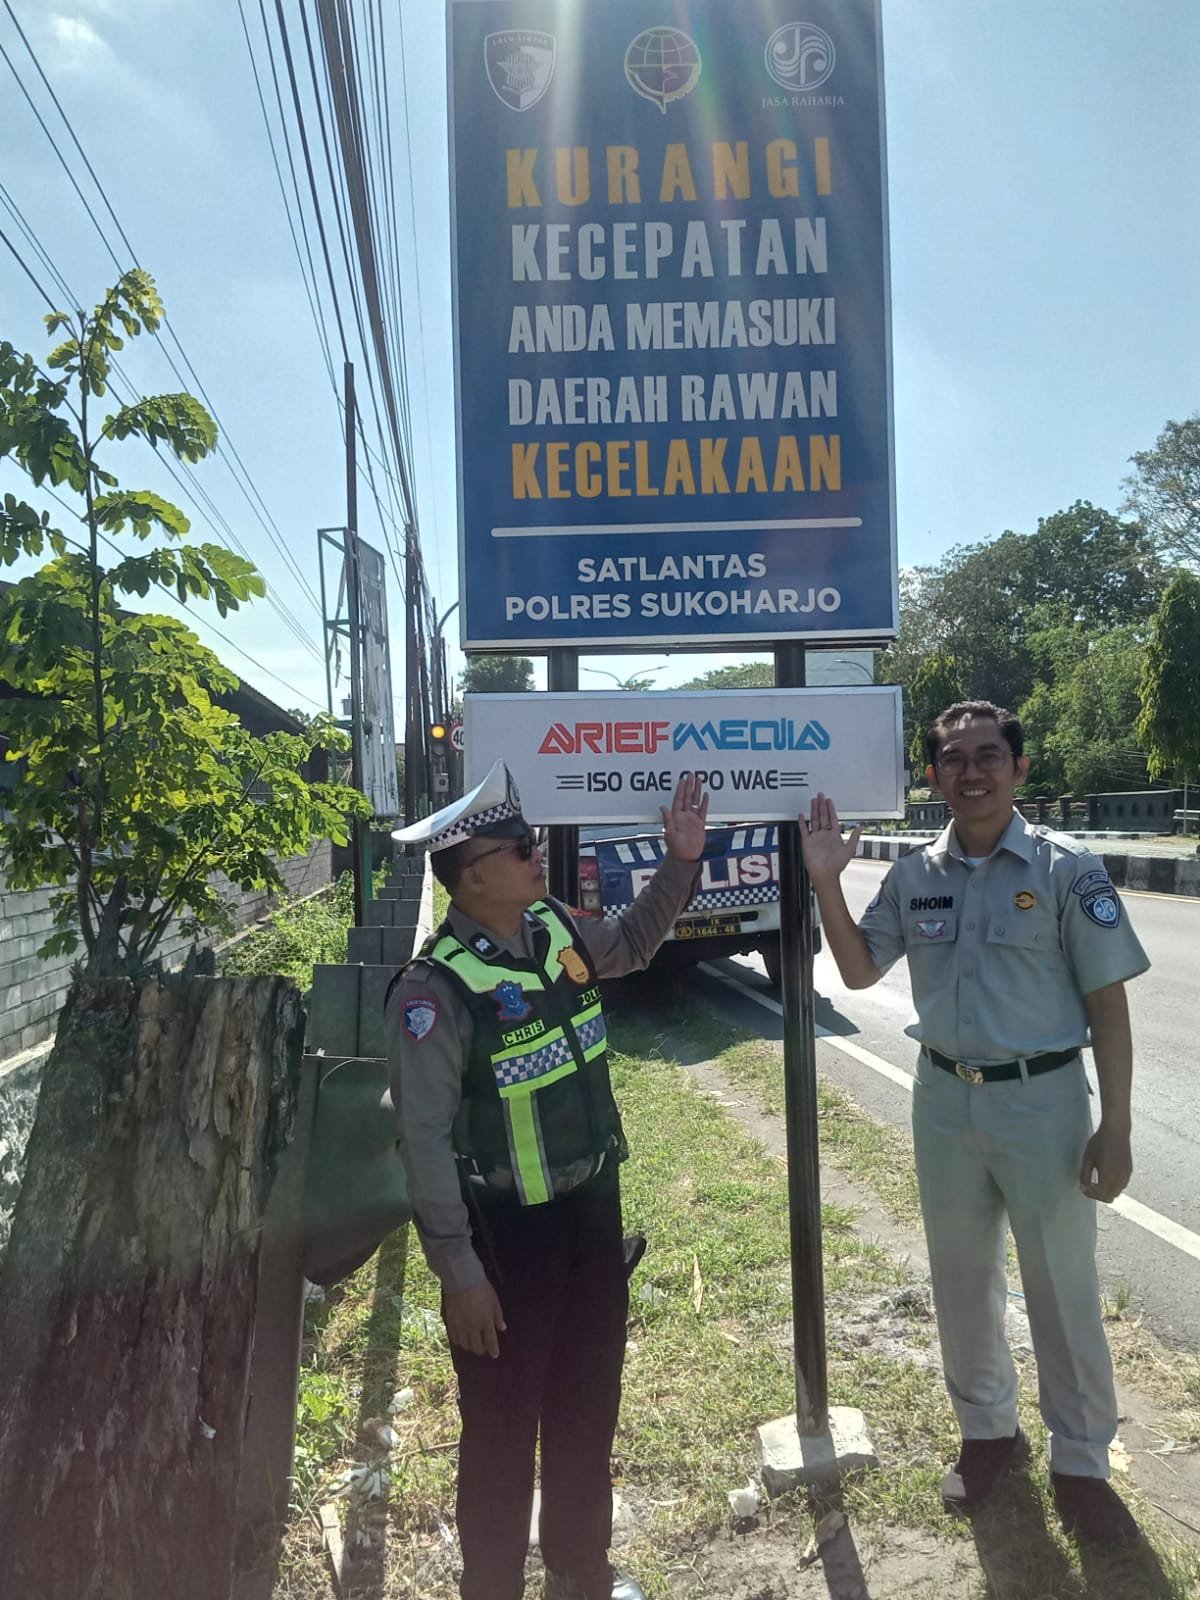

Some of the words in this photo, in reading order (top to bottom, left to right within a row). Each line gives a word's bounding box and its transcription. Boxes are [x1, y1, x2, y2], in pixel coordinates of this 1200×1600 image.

[762, 95, 789, 109] JASA
[791, 95, 845, 108] RAHARJA
[505, 137, 832, 208] KURANGI
[511, 217, 828, 281] KECEPATAN
[507, 303, 615, 353] ANDA
[626, 297, 836, 351] MEMASUKI
[508, 375, 668, 426] DAERAH
[681, 370, 838, 422] RAWAN
[511, 434, 842, 499] KECELAKAAN
[577, 552, 767, 582] SATLANTAS
[505, 593, 631, 621] POLRES
[640, 587, 842, 617] SUKOHARJO
[587, 771, 623, 792] ISO
[630, 771, 672, 792] GAE
[731, 769, 779, 791] WAE
[910, 896, 953, 911] SHOIM
[504, 1021, 543, 1045] CHRIS
